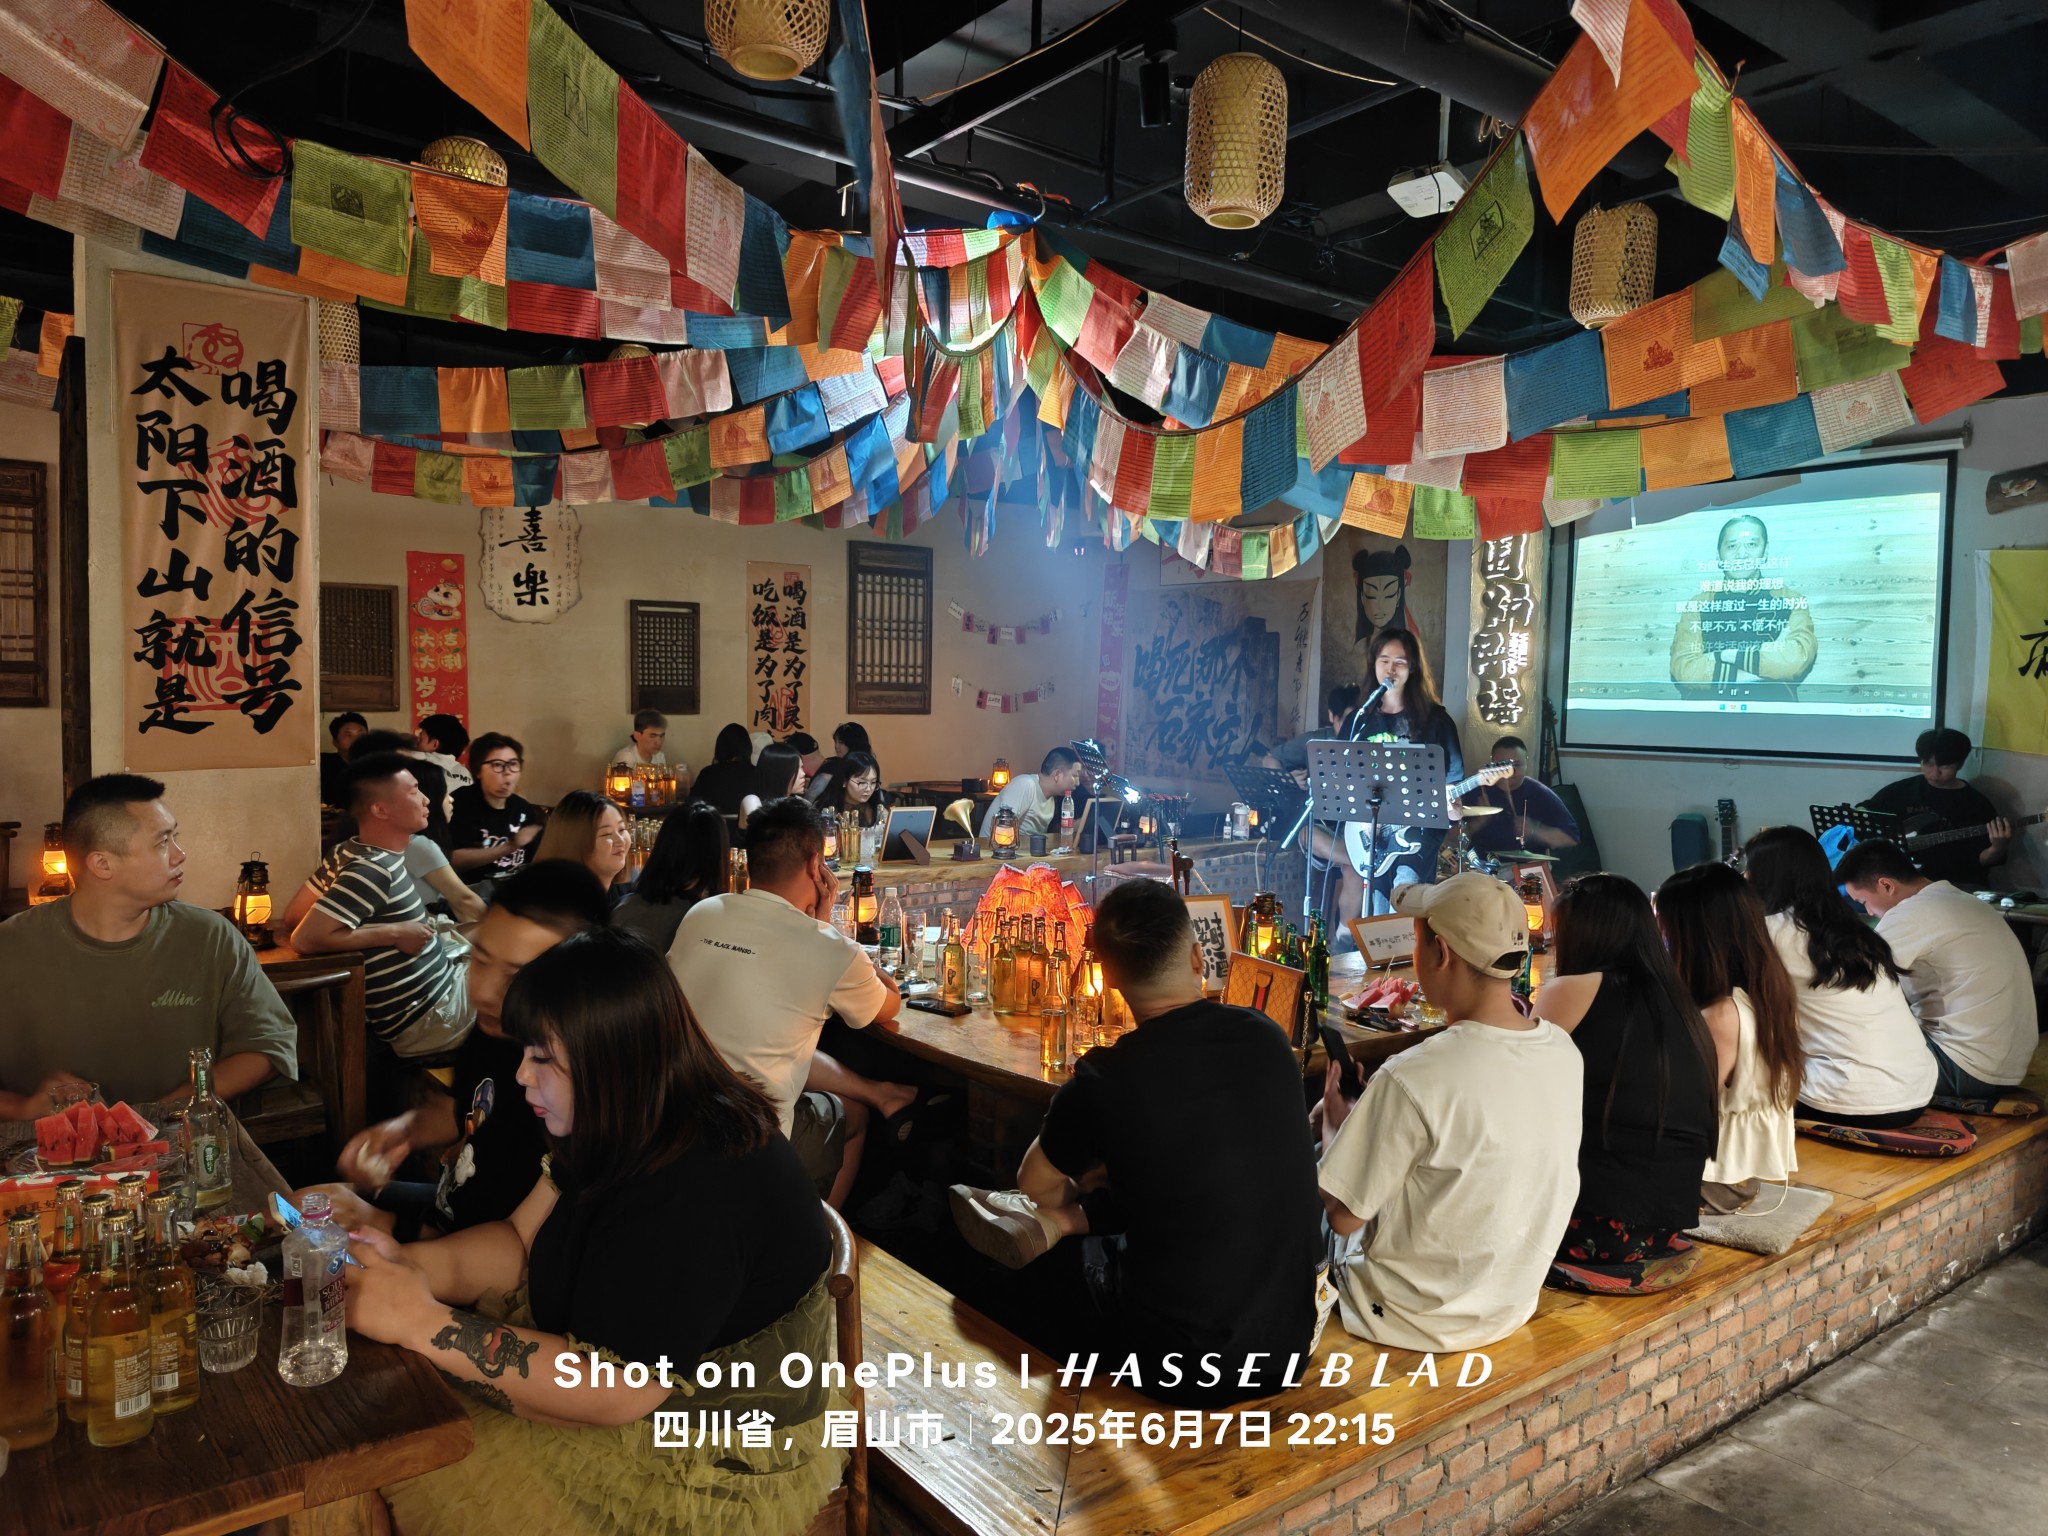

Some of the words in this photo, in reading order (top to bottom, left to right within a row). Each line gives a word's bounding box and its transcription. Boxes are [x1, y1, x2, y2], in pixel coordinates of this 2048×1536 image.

[130, 346, 217, 734] 太阳下山就是
[221, 359, 303, 734] 喝酒的信号
[1676, 597, 1808, 613] 就是这样度过一生的时光
[1700, 577, 1784, 592] 难道说我的理想
[752, 577, 780, 738] 吃饭是为了肉
[782, 580, 807, 740] 喝酒是为了灵
[1690, 620, 1737, 632] 不卑不亢
[1739, 618, 1790, 632] 不慌不忙
